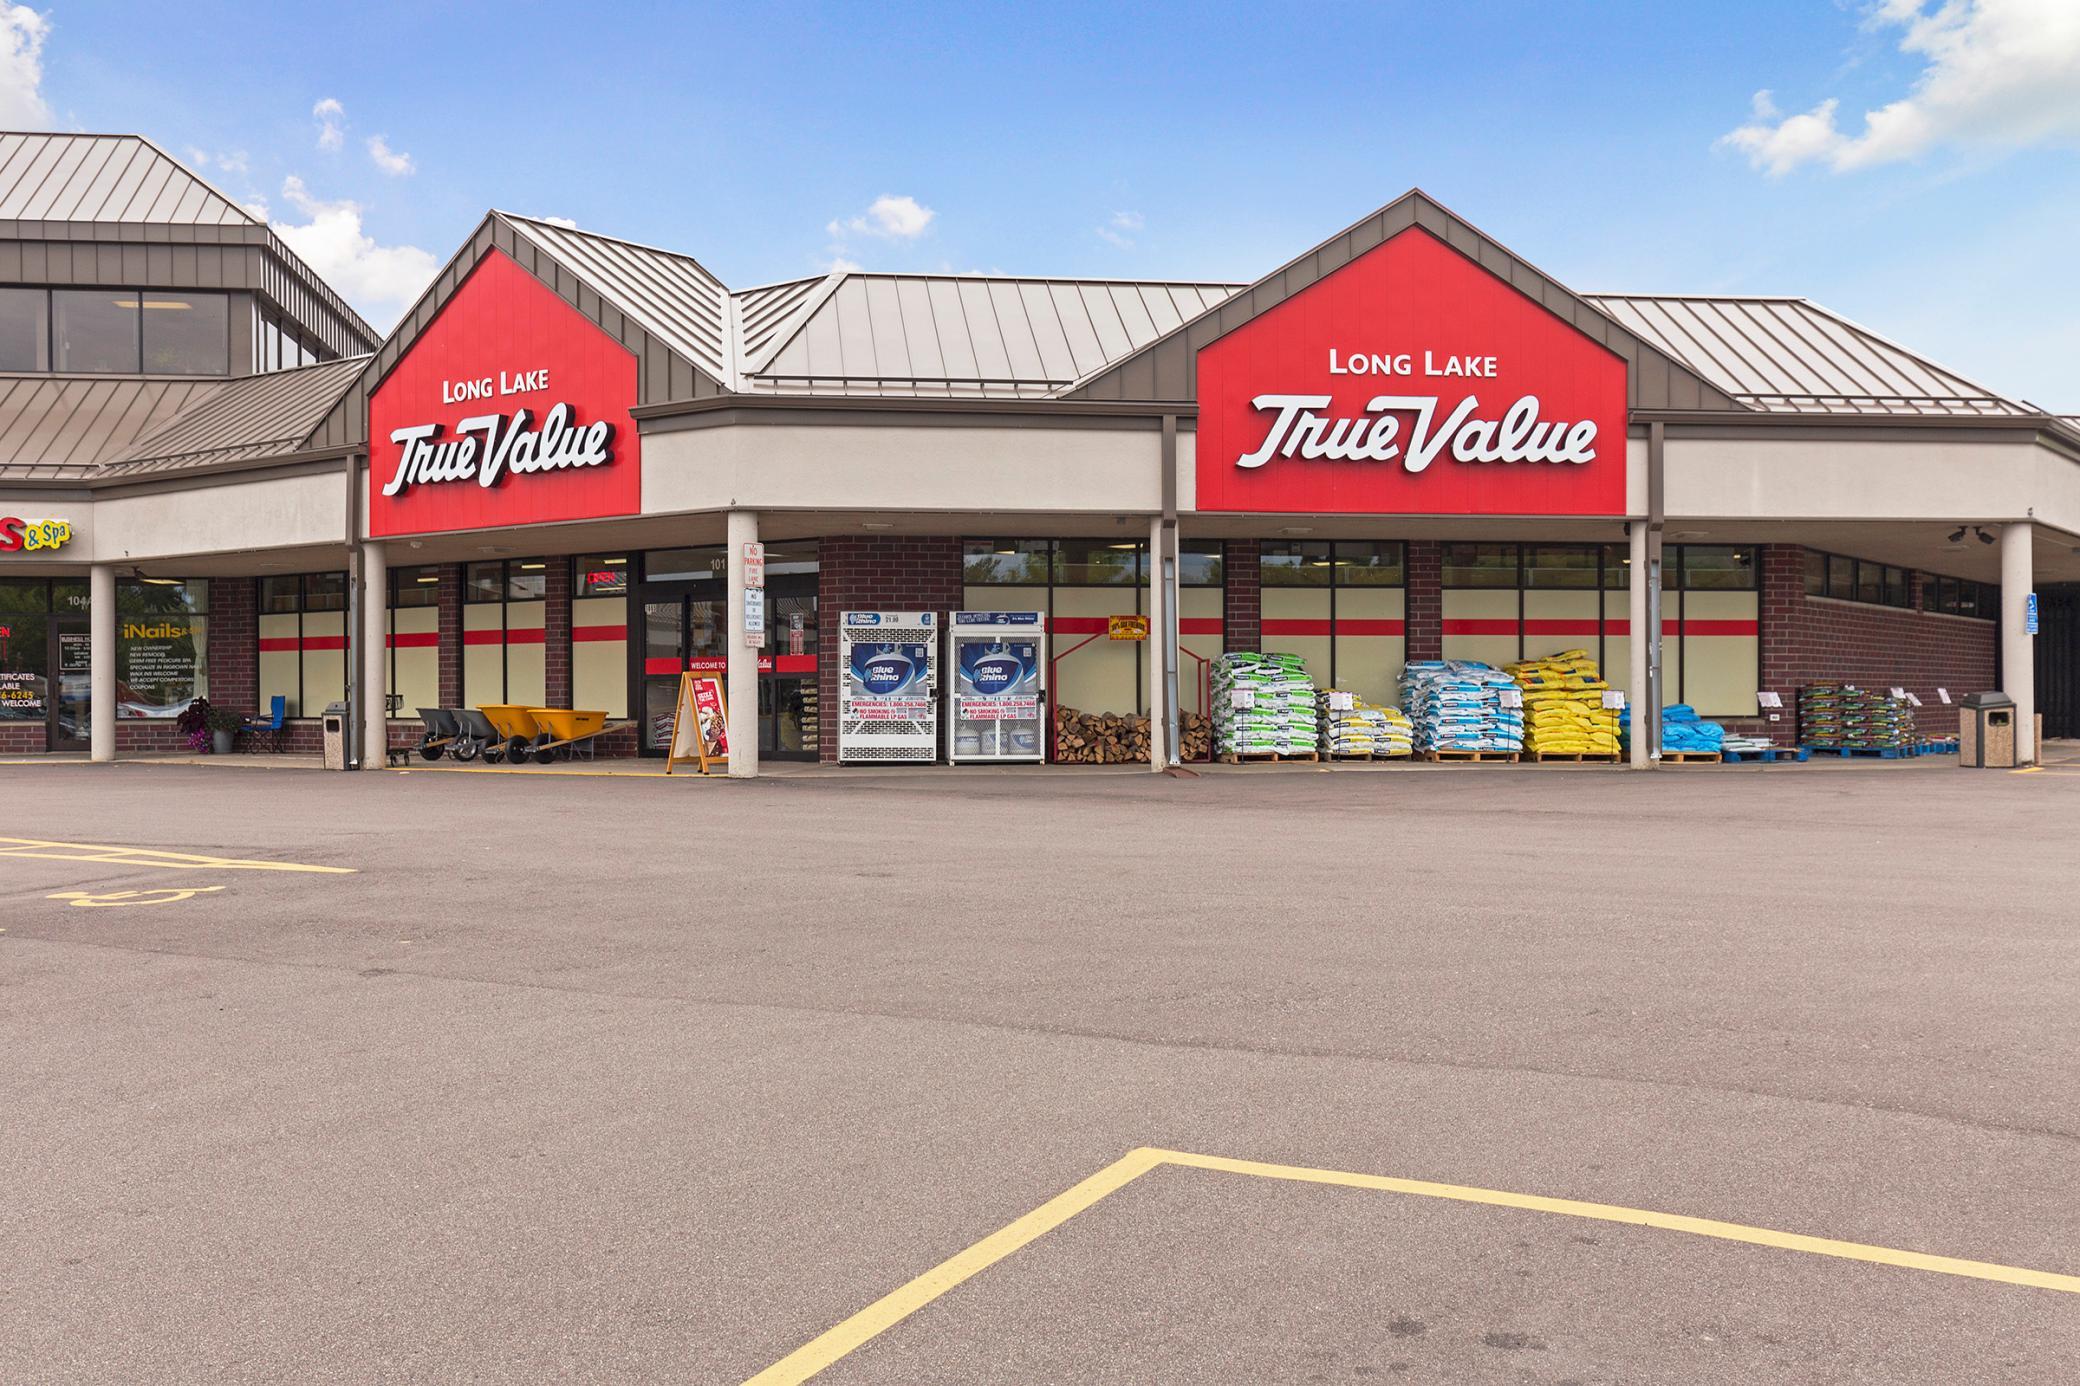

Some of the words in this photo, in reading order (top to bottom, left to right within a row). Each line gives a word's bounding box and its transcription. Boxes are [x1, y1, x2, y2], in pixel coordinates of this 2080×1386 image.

[1235, 394, 1400, 468] True
[1367, 394, 1598, 473] Value
[382, 424, 479, 496] True
[456, 402, 612, 488] Value
[28, 528, 39, 547] &
[42, 523, 66, 545] Spa
[710, 559, 726, 570] 101
[587, 571, 616, 584] OPEN
[123, 623, 182, 639] iNails
[2, 700, 41, 708] WELCOME
